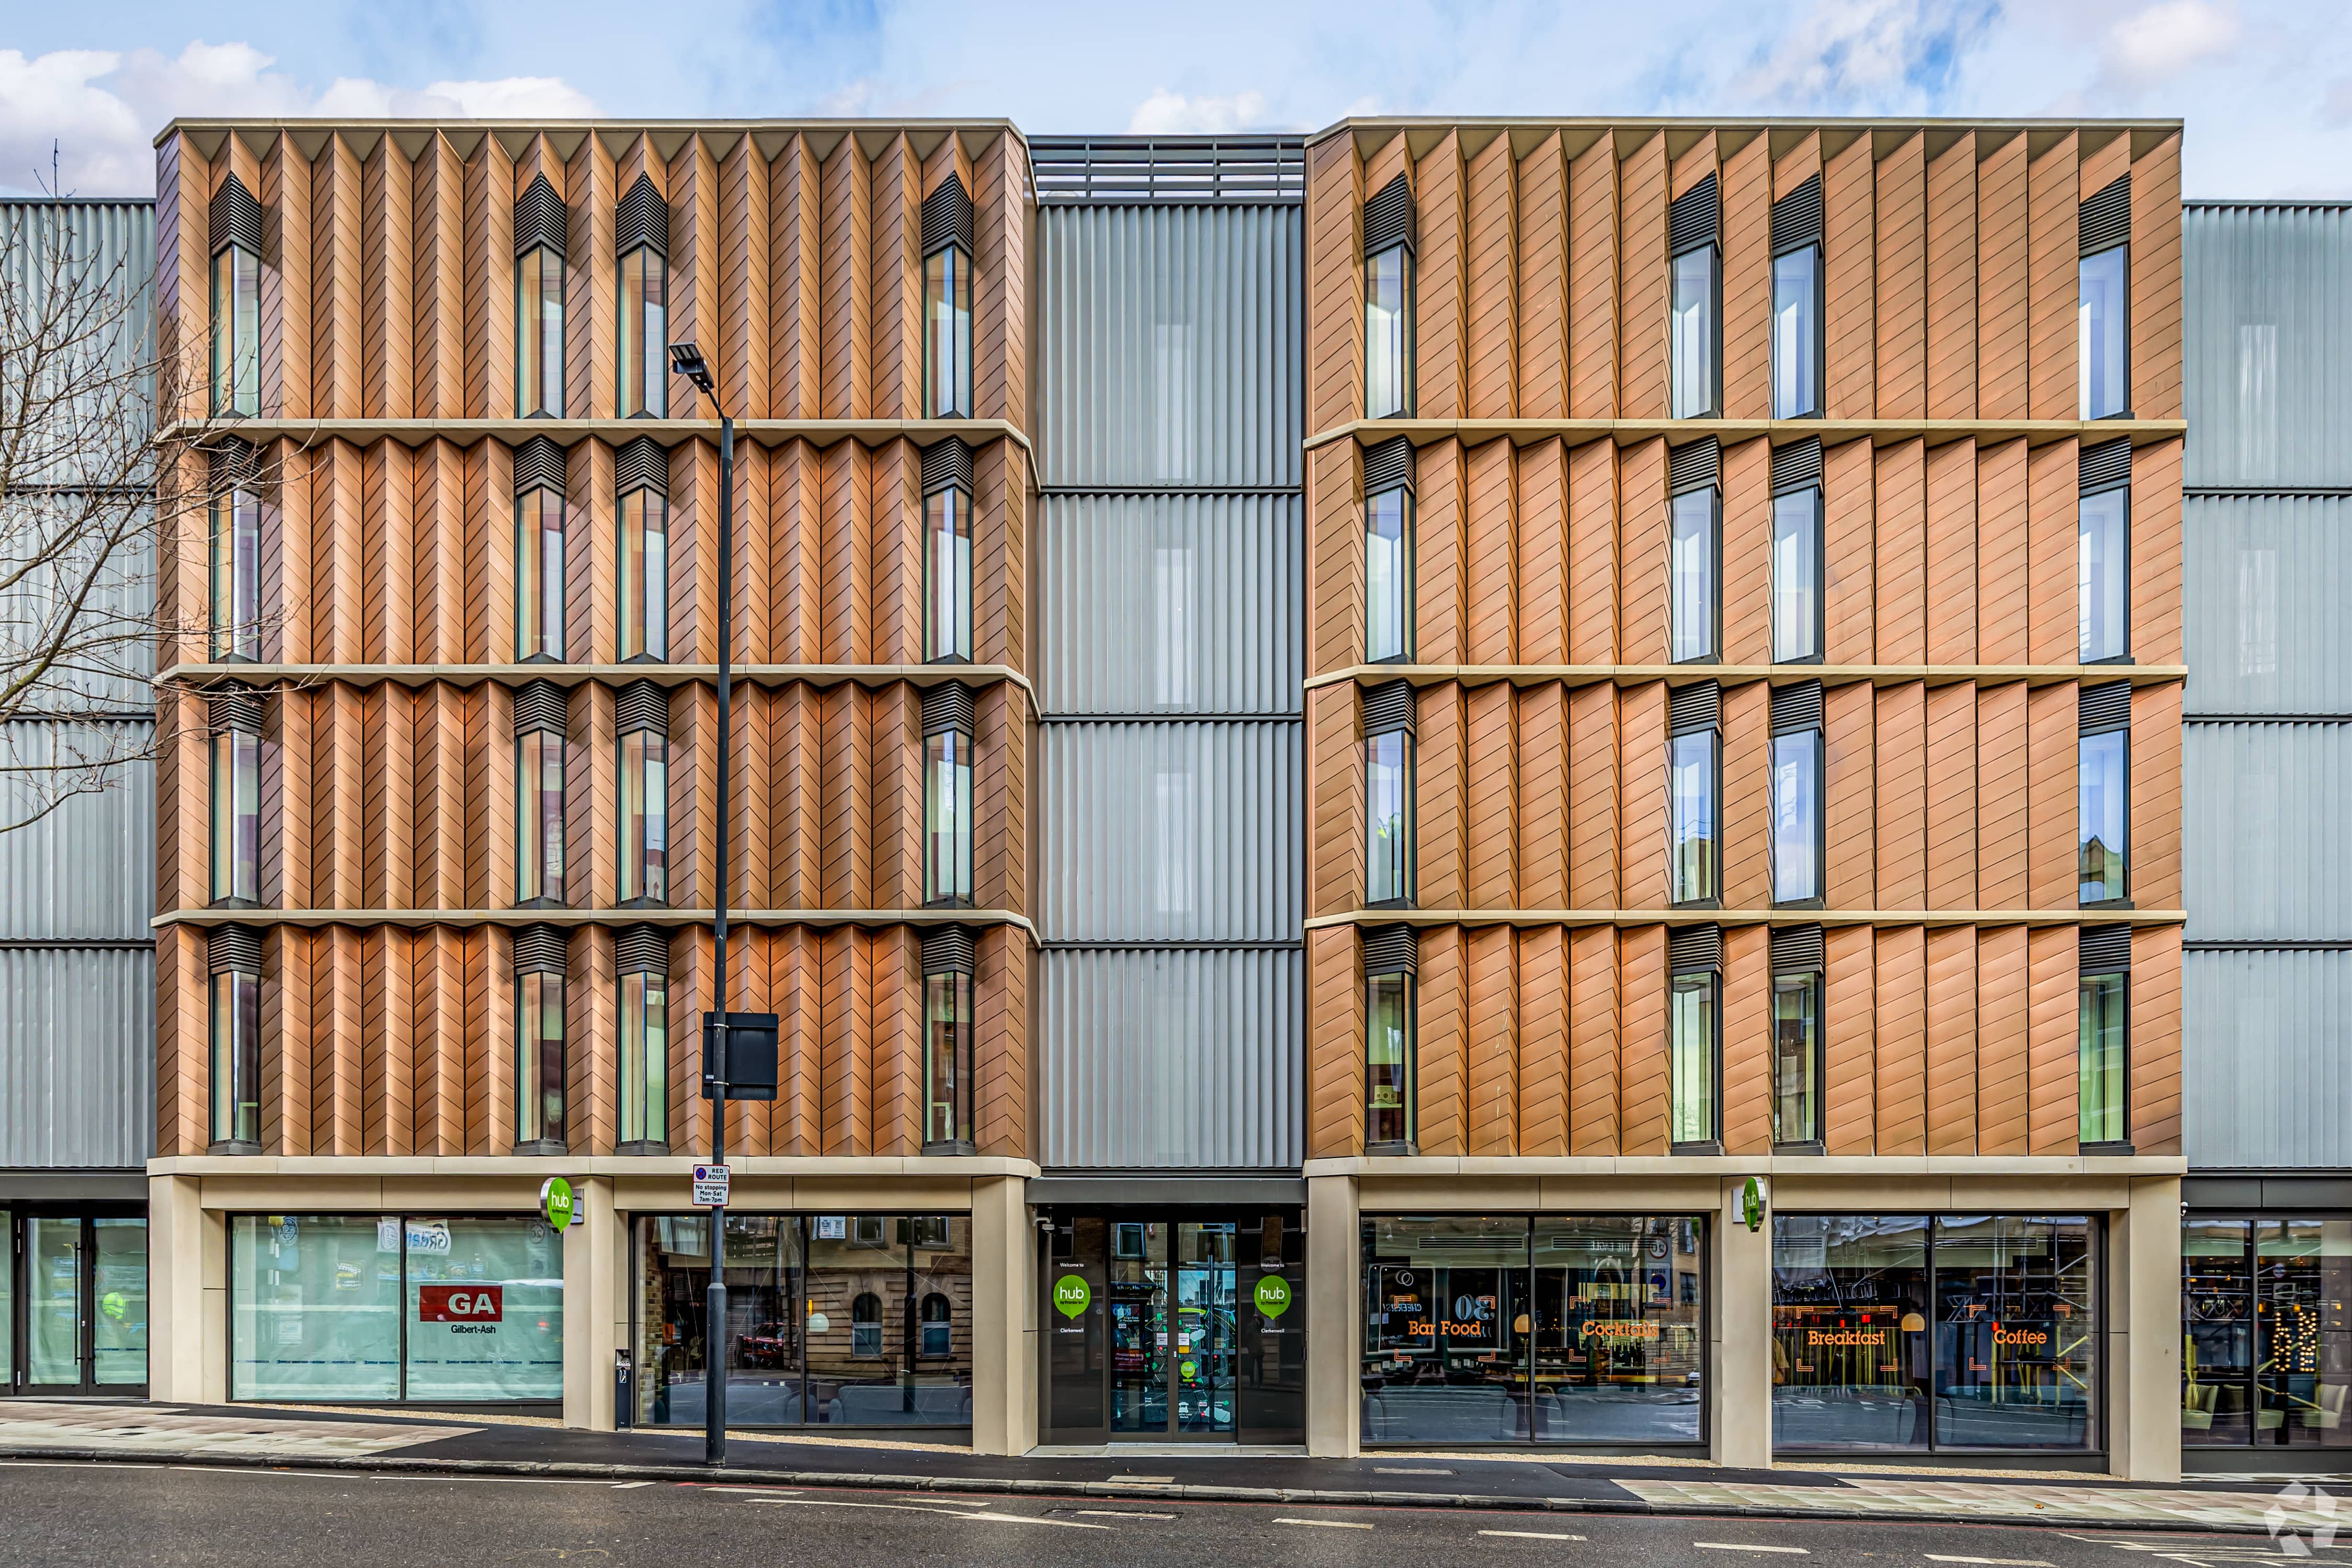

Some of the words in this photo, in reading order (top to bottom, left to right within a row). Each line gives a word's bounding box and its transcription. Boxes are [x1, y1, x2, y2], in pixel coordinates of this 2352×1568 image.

[551, 1190, 569, 1208] hub
[1745, 1190, 1757, 1208] hub
[1060, 1286, 1084, 1299] hub
[1260, 1286, 1285, 1300] hub
[448, 1293, 496, 1315] GA
[451, 1325, 496, 1334] Gilbert-Ash
[1408, 1321, 1436, 1335] Bar
[1441, 1321, 1481, 1335] Food
[1582, 1321, 1660, 1337] Cocktails
[1808, 1331, 1884, 1345] Breakfast
[1993, 1330, 2047, 1344] Coffee
